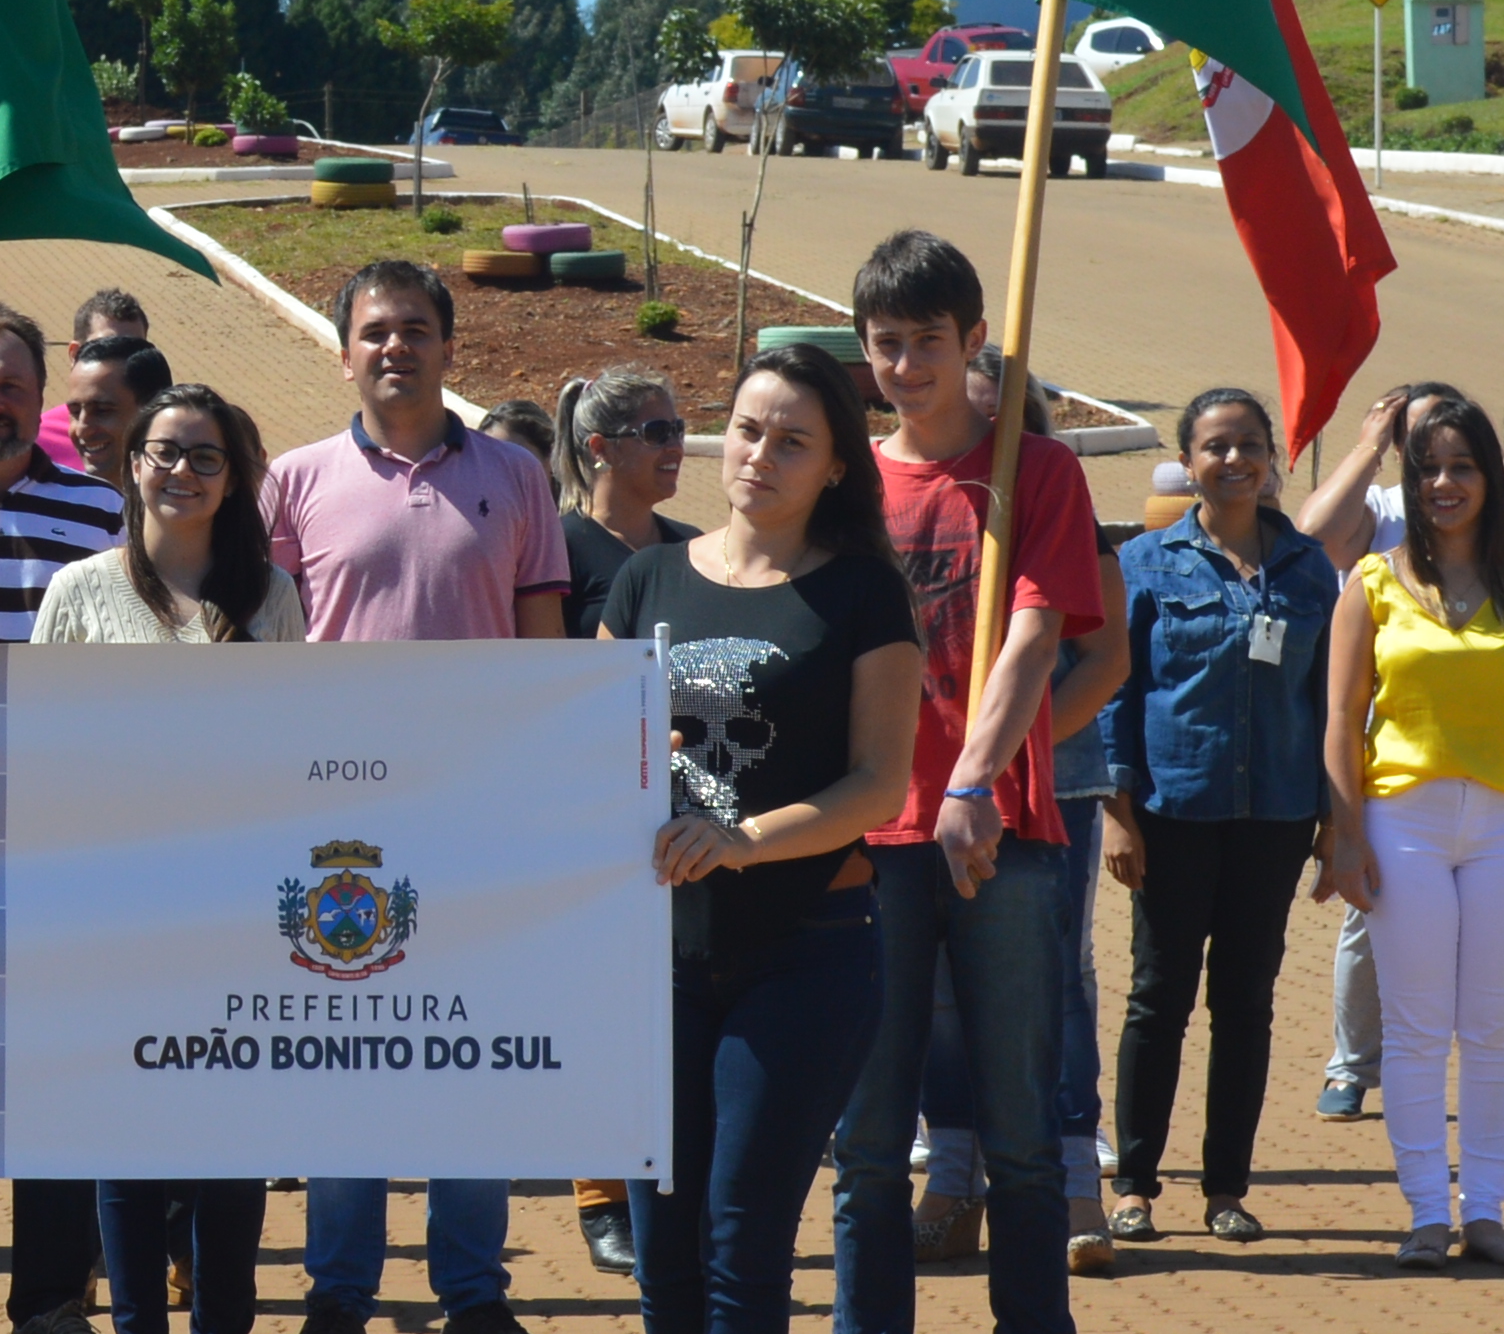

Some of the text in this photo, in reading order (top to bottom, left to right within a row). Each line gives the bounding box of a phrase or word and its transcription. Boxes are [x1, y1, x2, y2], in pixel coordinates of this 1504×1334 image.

[307, 759, 388, 782] APOIO
[226, 993, 469, 1022] PREFEITURA
[133, 1027, 562, 1071] CAPÃO BONITO DO SUL
